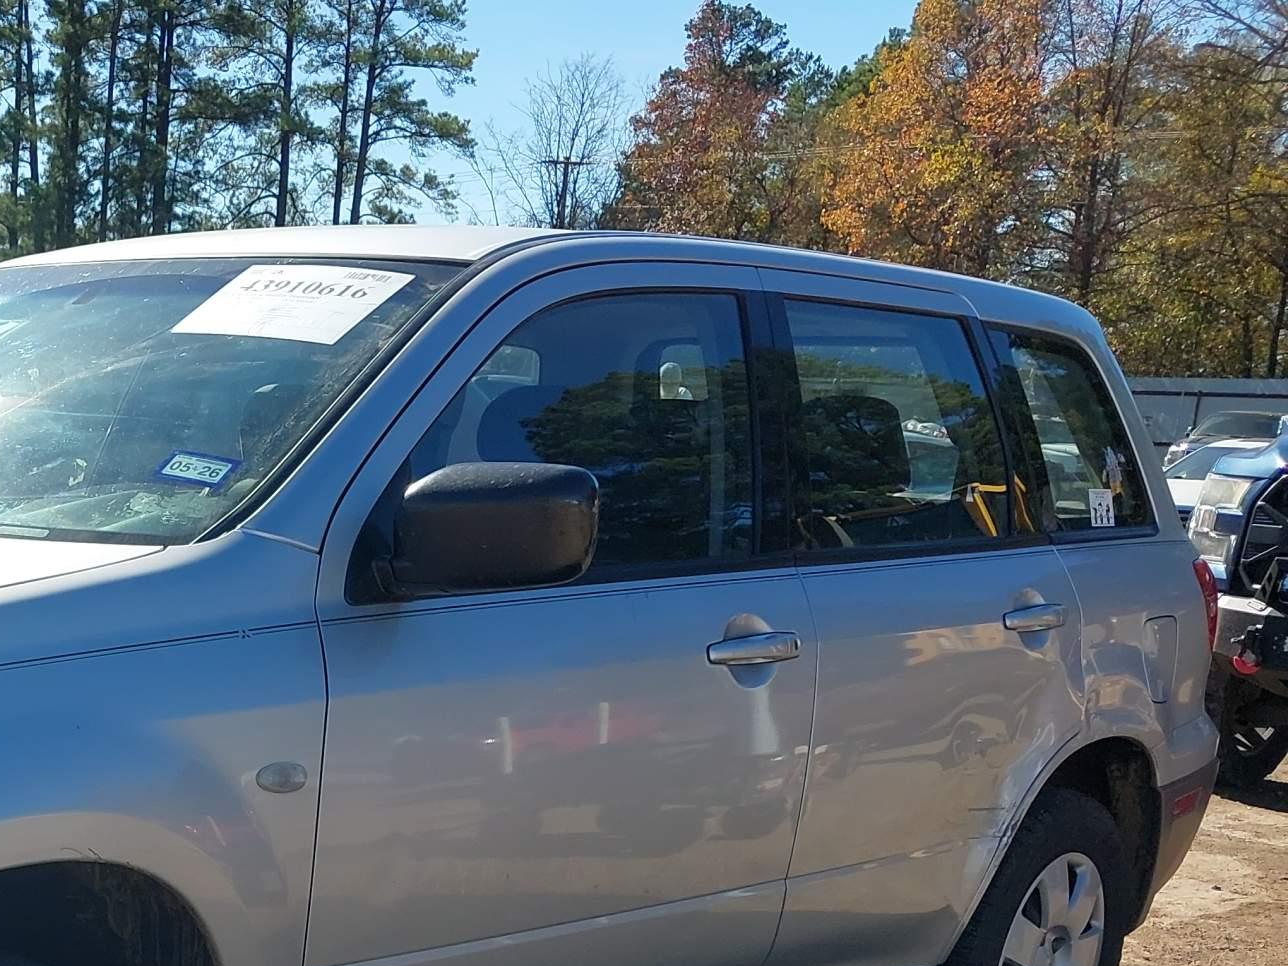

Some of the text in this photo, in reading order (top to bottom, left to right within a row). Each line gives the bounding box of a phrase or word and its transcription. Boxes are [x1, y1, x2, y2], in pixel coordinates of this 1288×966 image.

[241, 279, 369, 299] 43910616
[169, 461, 193, 472] 05
[197, 466, 222, 478] 26
